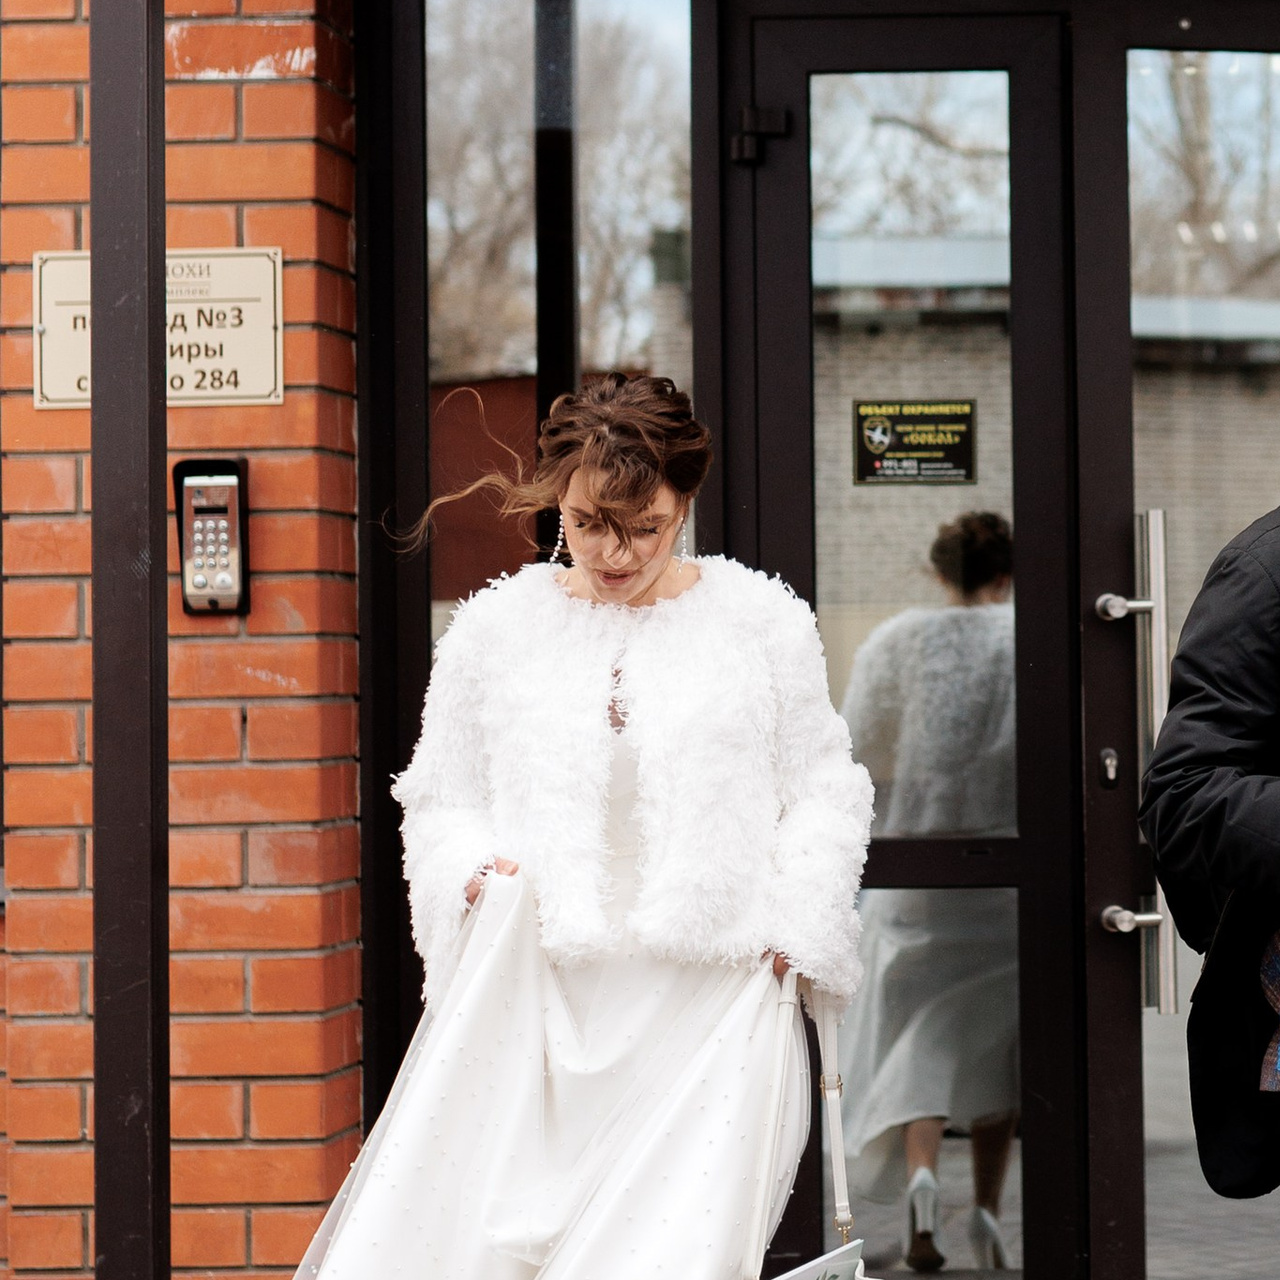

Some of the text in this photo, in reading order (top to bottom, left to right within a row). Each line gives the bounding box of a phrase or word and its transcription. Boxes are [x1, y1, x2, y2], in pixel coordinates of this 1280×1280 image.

[166, 262, 211, 278] ОХИ
[196, 307, 243, 328] №3
[194, 369, 239, 390] 284
